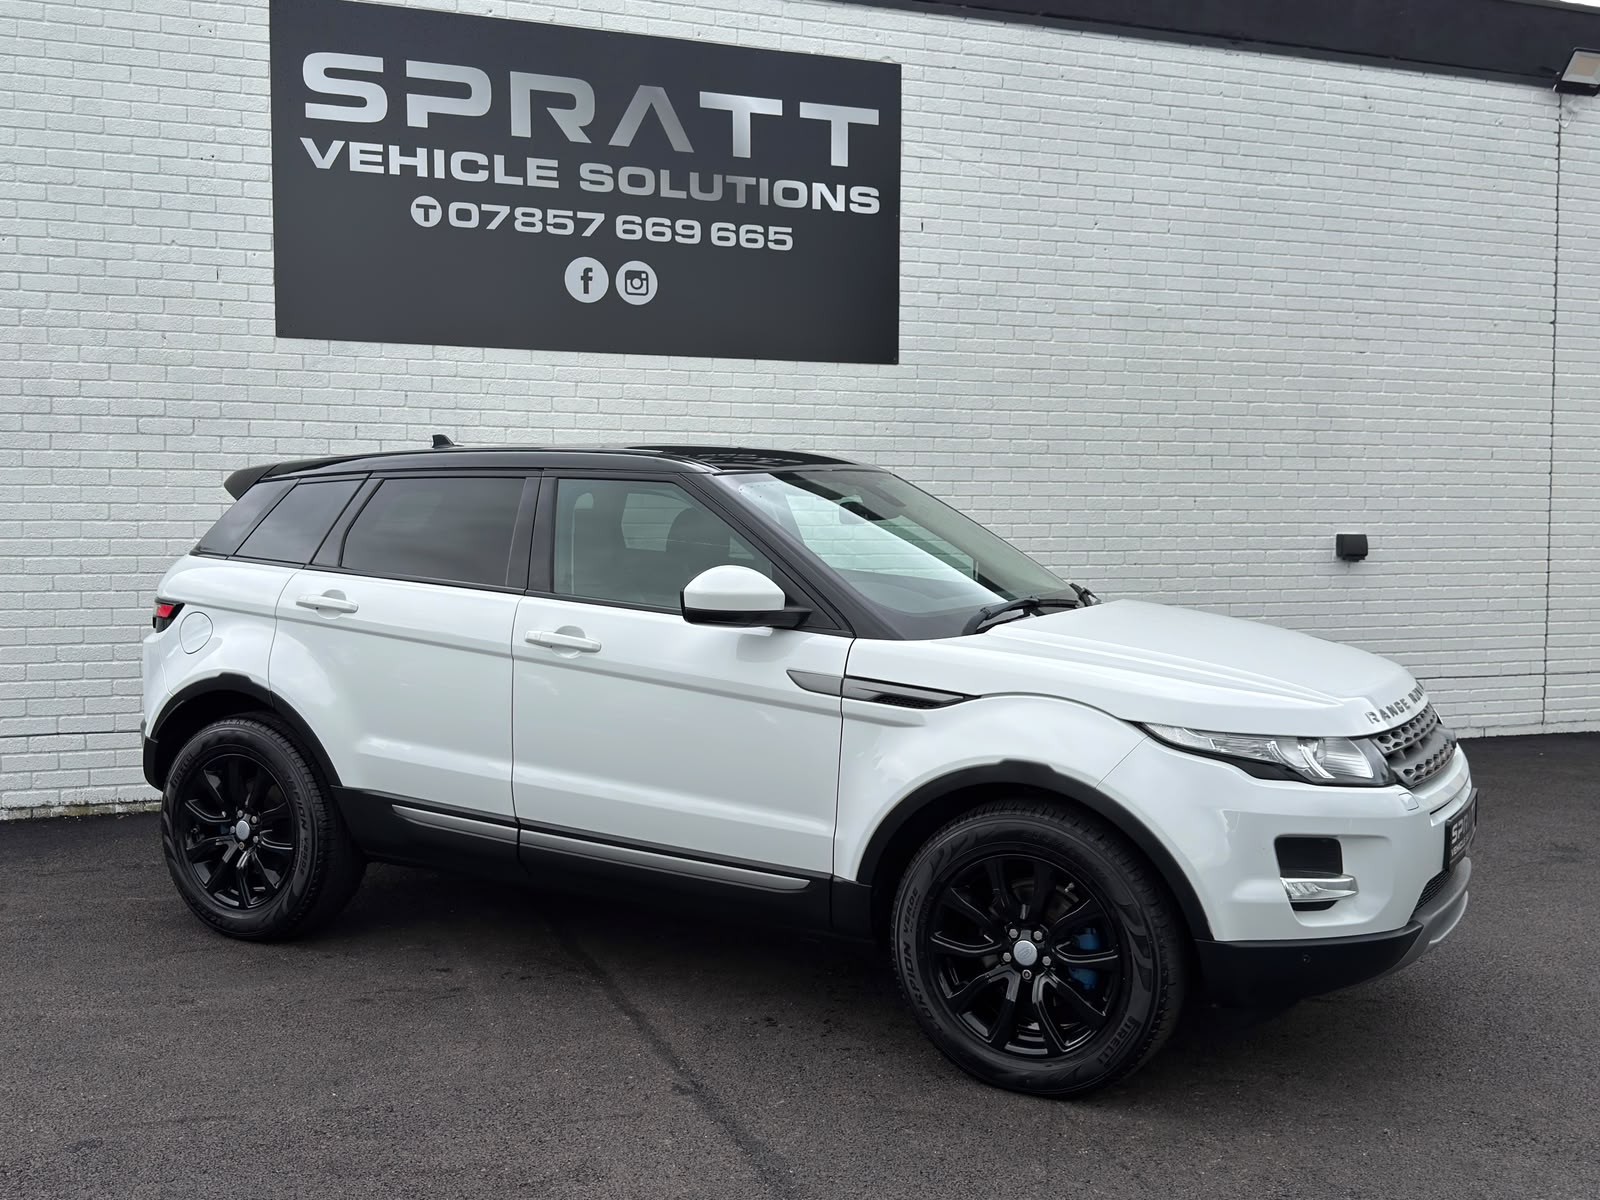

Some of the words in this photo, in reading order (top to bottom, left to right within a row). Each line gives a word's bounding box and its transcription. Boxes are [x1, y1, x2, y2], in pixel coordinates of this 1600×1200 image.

[302, 51, 880, 168] SPRATT
[299, 136, 560, 189] VEHICLE
[579, 162, 880, 215] SOLUTIONS
[447, 201, 606, 238] 07857
[615, 214, 702, 245] 669
[710, 221, 794, 251] 665
[1364, 698, 1411, 724] RANGE
